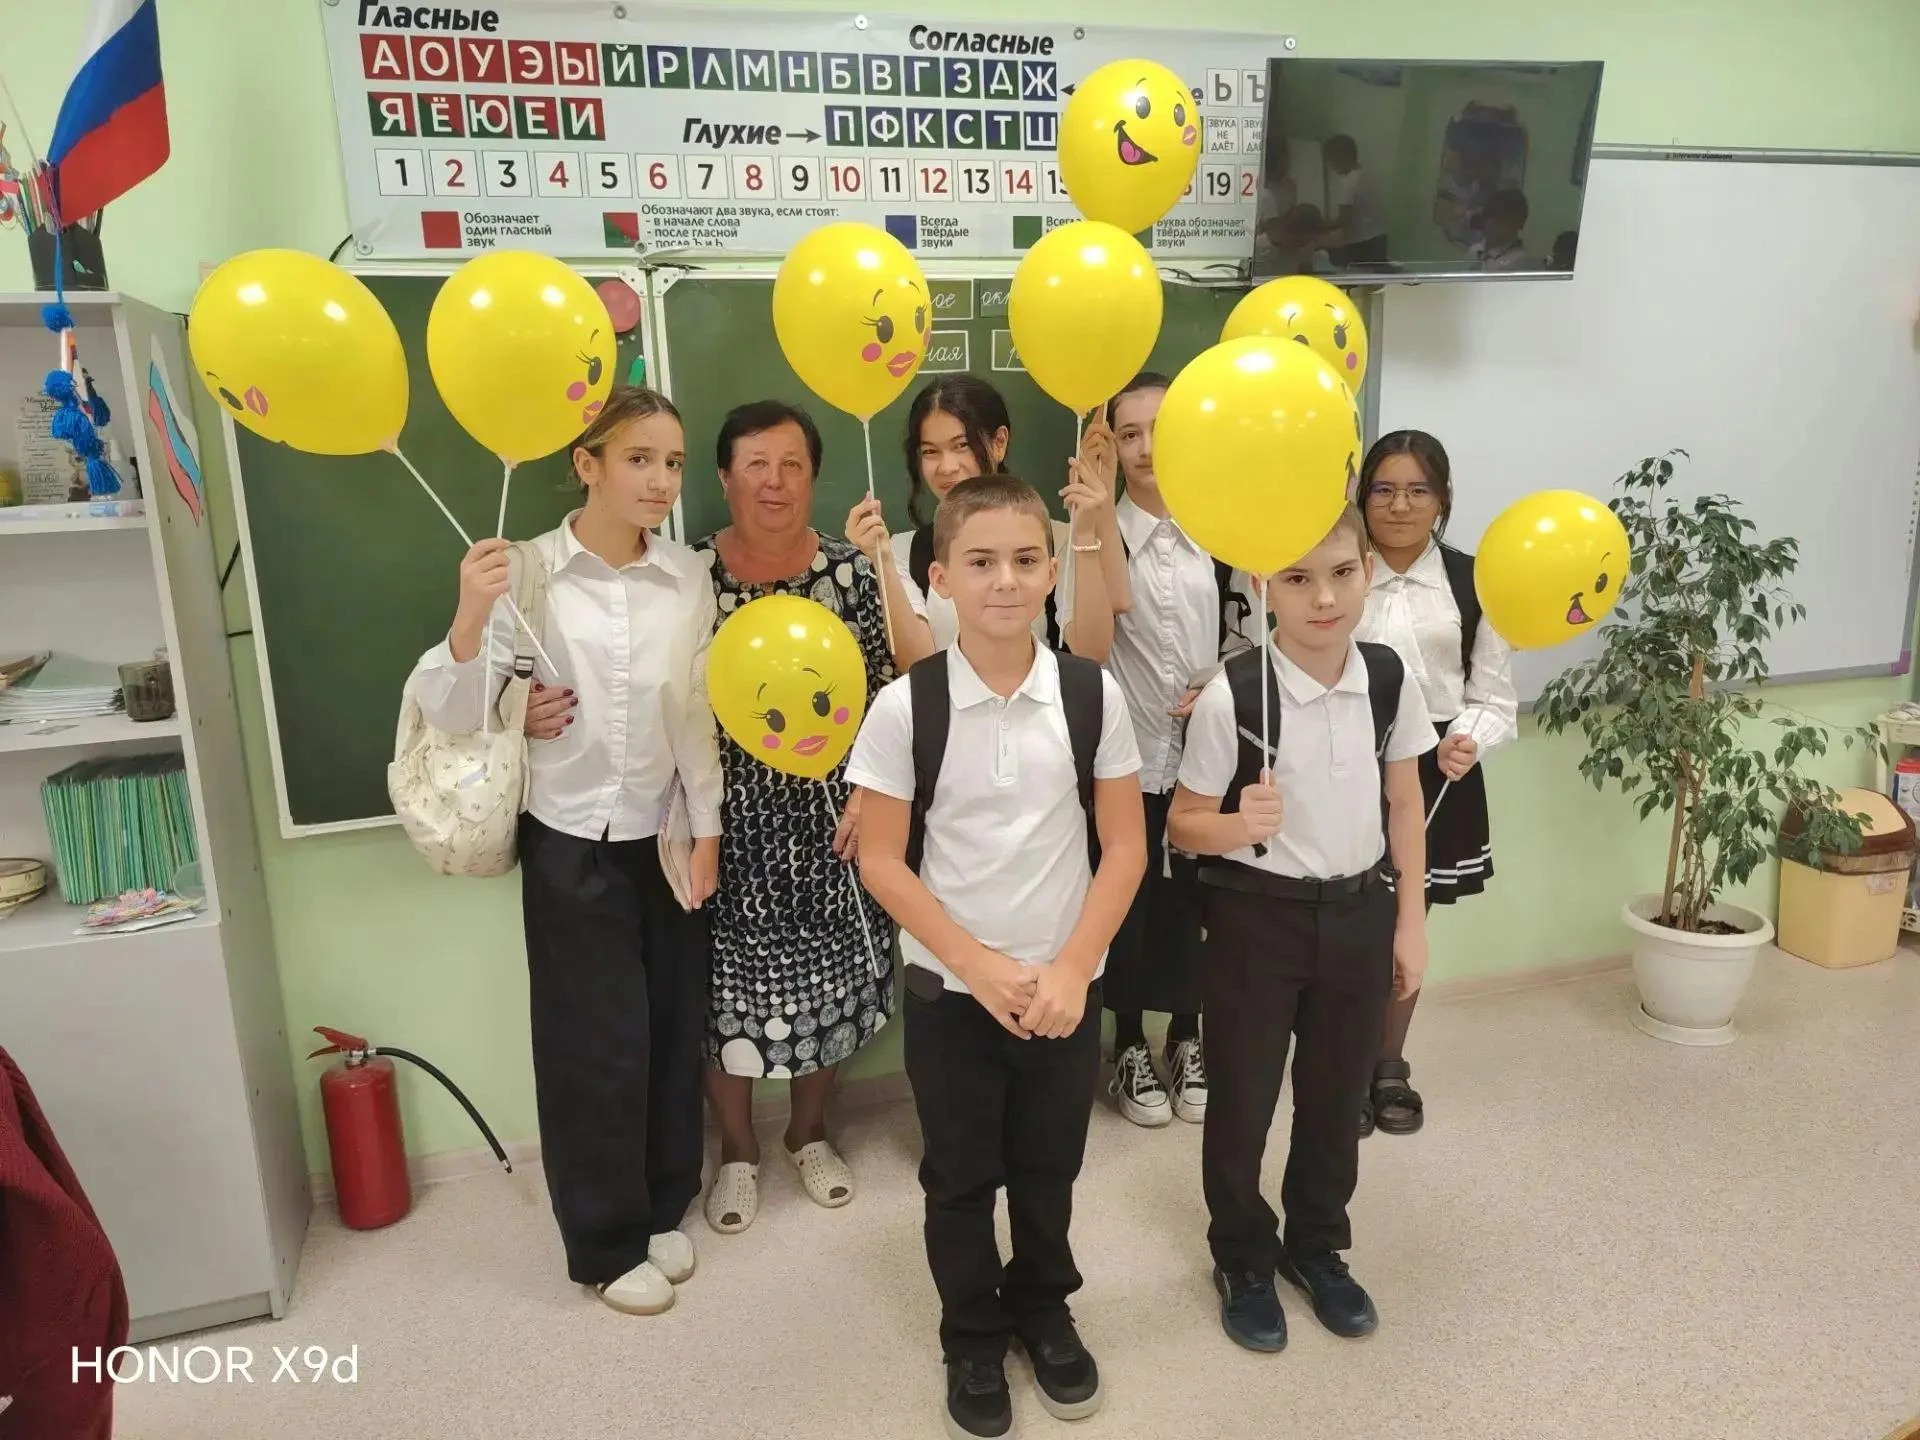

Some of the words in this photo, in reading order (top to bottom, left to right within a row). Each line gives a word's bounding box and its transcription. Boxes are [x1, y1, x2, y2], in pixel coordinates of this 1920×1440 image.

[357, 0, 500, 32] Гласные
[909, 25, 1054, 55] Согласные
[372, 39, 402, 75] А
[419, 41, 450, 77] О
[468, 44, 495, 78] У
[518, 46, 545, 80] Э
[562, 48, 594, 82] Ы
[611, 45, 636, 83] Й
[657, 52, 679, 84] Р
[702, 53, 727, 86] Л
[743, 55, 771, 87] М
[788, 55, 811, 88] Н
[831, 58, 851, 90] Б
[872, 59, 893, 92] В
[913, 61, 931, 93] Г
[953, 62, 973, 94] З
[990, 63, 1014, 96] Д
[1023, 65, 1056, 97] Ж
[1215, 73, 1232, 102] Ь
[381, 98, 407, 132] Я
[430, 97, 452, 133] Ё
[470, 100, 509, 134] Ю
[526, 102, 547, 135] Е
[571, 103, 597, 136] И
[832, 111, 856, 142] П
[870, 111, 900, 143] Ф
[914, 113, 935, 144] К
[954, 113, 974, 144] С
[993, 115, 1012, 145] Т
[1026, 116, 1056, 147] Ш
[1208, 119, 1237, 128] ЗВУКА
[1244, 120, 1263, 128] ЗВУ
[683, 118, 782, 149] Глухие
[1216, 131, 1229, 139] НЕ
[1211, 141, 1235, 151] ДАЁТ
[395, 158, 408, 187] 1
[445, 159, 465, 188] 2
[499, 160, 517, 188] 3
[549, 160, 569, 188] 4
[600, 162, 618, 189] 5
[649, 163, 667, 190] 6
[697, 164, 714, 190] 7
[745, 164, 763, 191] 8
[791, 165, 809, 192] 9
[829, 166, 861, 192] 10
[880, 166, 901, 193] 11
[920, 168, 948, 194] 12
[963, 168, 990, 195] 13
[1004, 169, 1033, 195] 14
[1206, 172, 1231, 196] 19
[641, 204, 714, 216] Обозначают
[716, 207, 737, 217] два
[739, 208, 774, 218] звука,
[776, 209, 802, 217] если
[805, 208, 840, 217] стоят:
[464, 212, 540, 224] Обозначает
[653, 218, 661, 226] в
[663, 218, 705, 227] начале
[707, 218, 740, 227] слова
[920, 216, 958, 228] Всегда
[1189, 217, 1245, 228] обозначает
[465, 226, 497, 236] один
[500, 224, 552, 236] гласный
[655, 229, 690, 238] после
[692, 227, 738, 238] гласной
[920, 227, 969, 238] твёрдые
[1157, 228, 1200, 238] твёрдый
[1203, 229, 1209, 237] и
[1211, 228, 1245, 238] мягкий
[467, 238, 495, 249] звук
[921, 239, 953, 250] звуки
[1157, 240, 1185, 249] звуки
